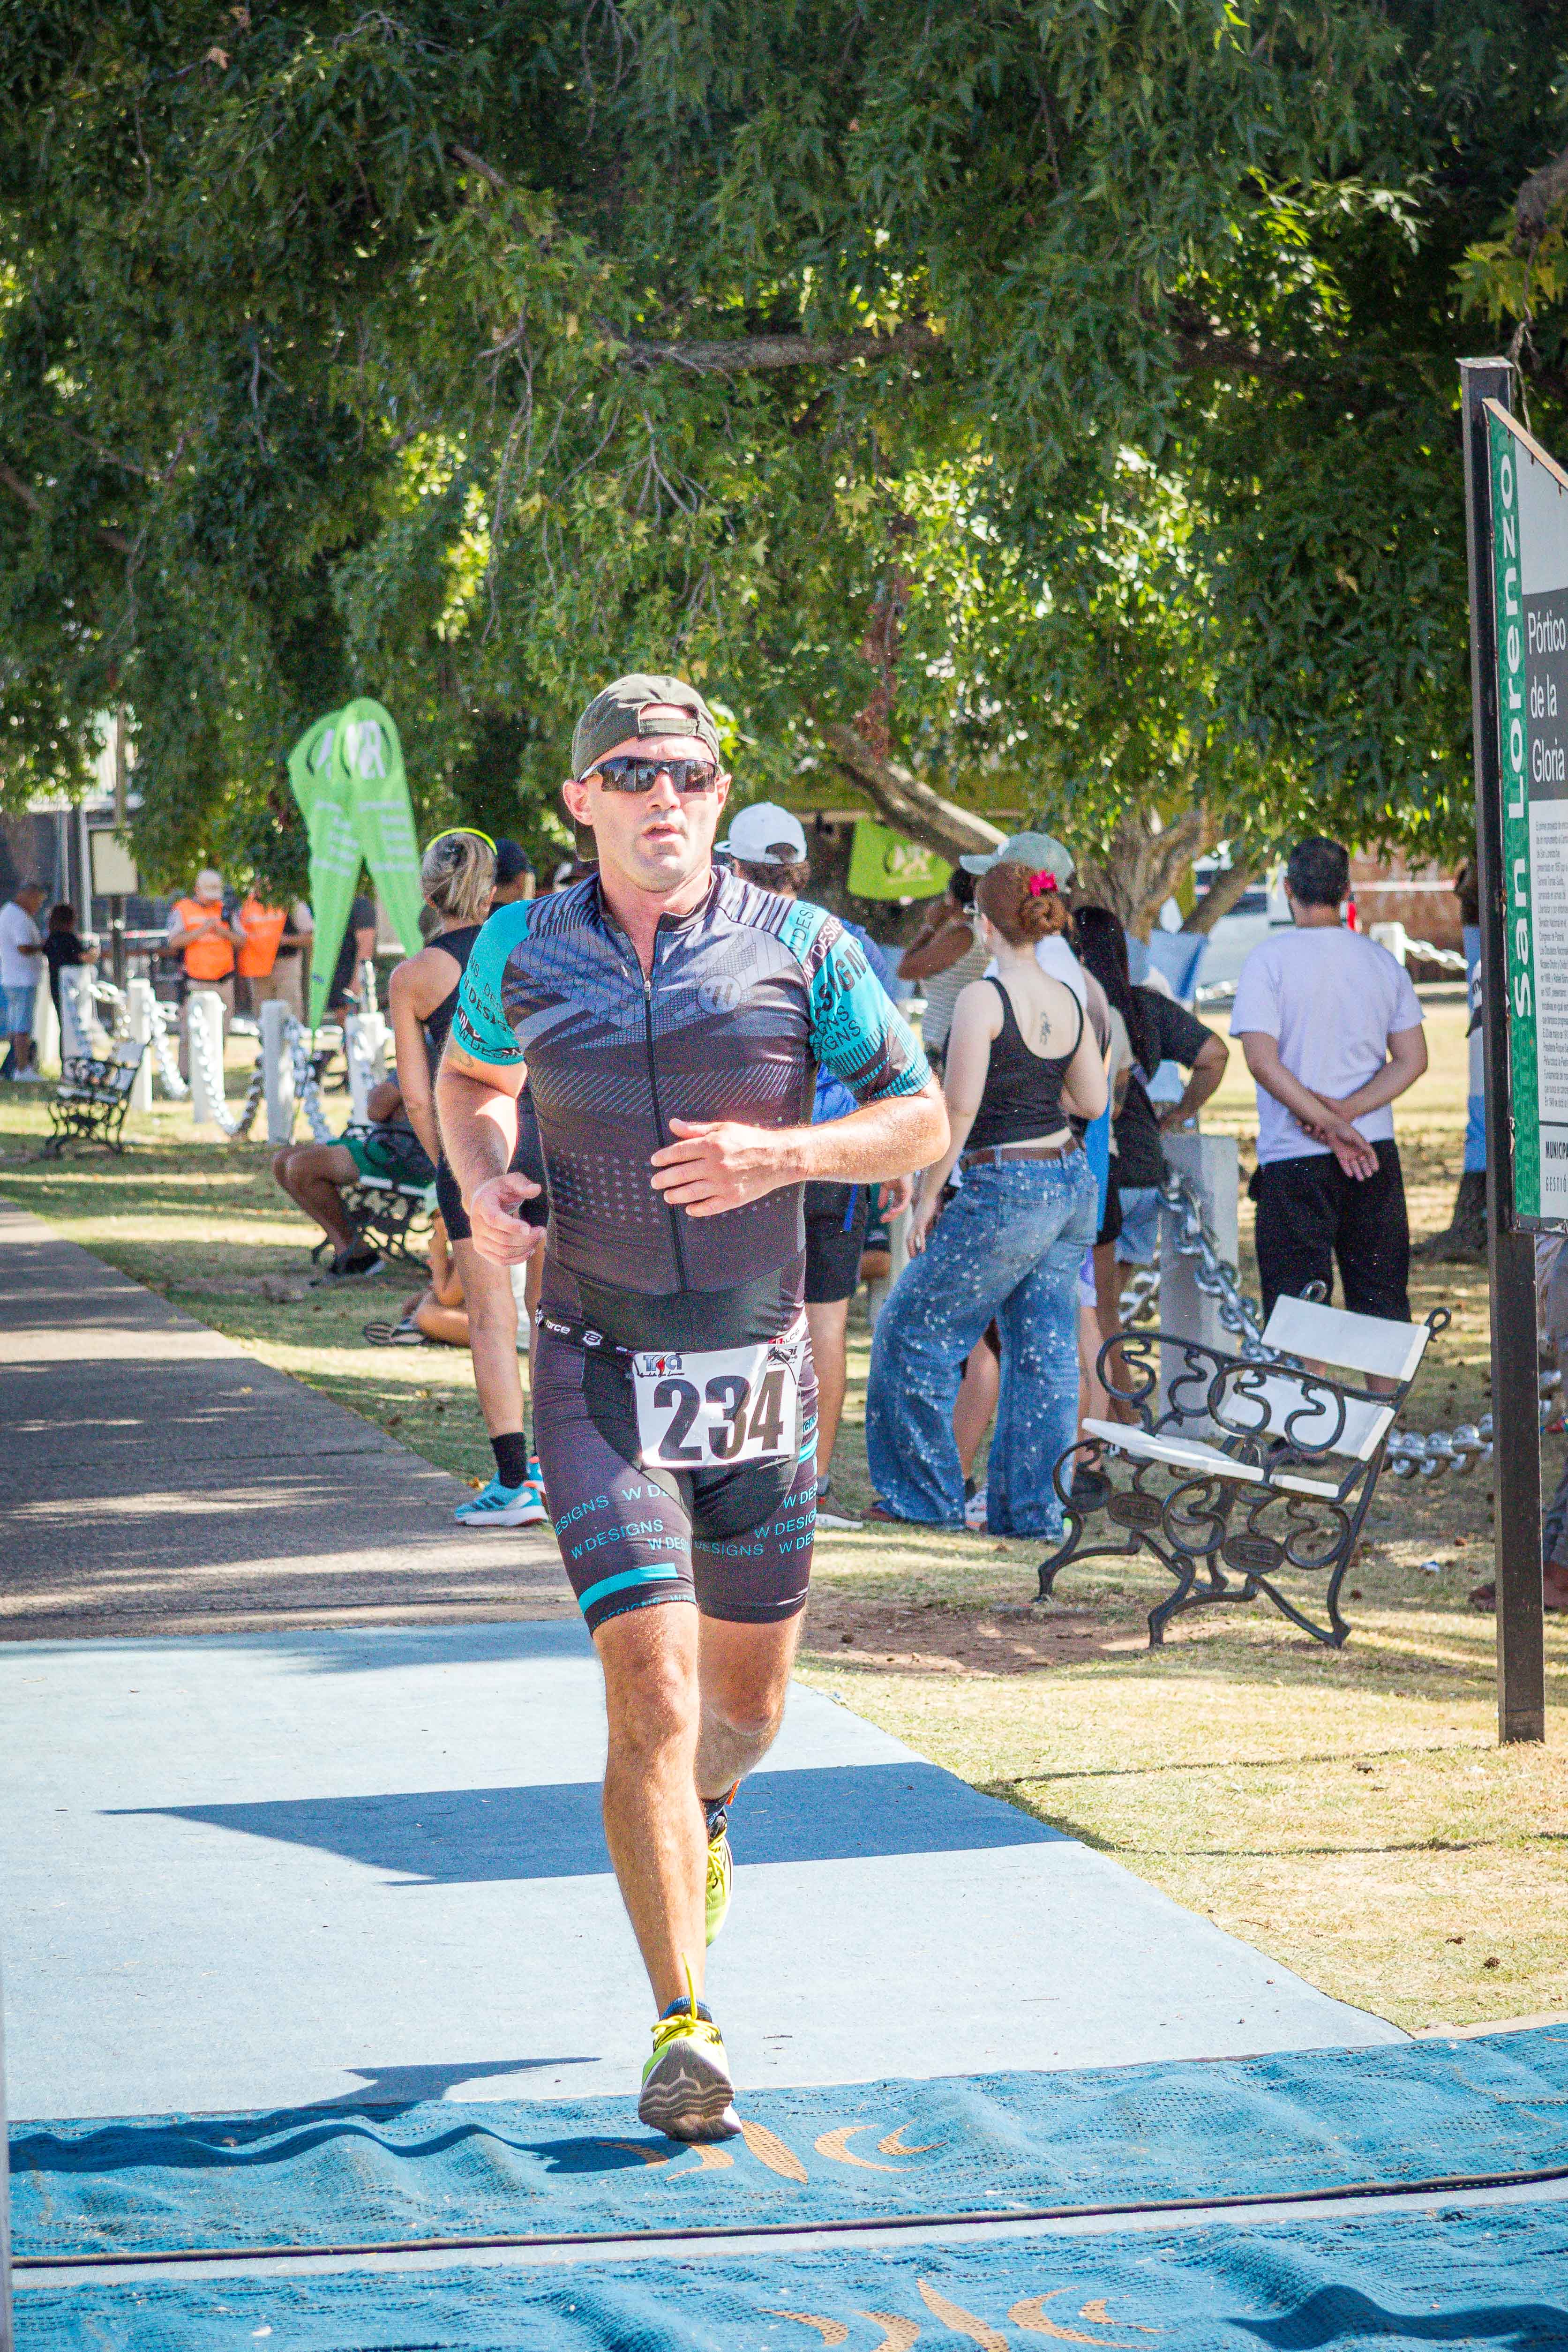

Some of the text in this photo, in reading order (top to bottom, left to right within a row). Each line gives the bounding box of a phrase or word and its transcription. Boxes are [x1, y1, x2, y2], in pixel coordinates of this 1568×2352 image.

[1528, 609, 1566, 655] Pórtico
[1530, 673, 1558, 719] de la
[1501, 454, 1531, 1018] San Lorenzo
[1532, 737, 1566, 783] Gloria
[654, 1370, 786, 1461] 234
[622, 1486, 642, 1500] W
[784, 1494, 797, 1509] W
[570, 1519, 664, 1559] W DESIGNS
[646, 1537, 662, 1551] W
[754, 1526, 770, 1539] W
[779, 1540, 793, 1554] W
